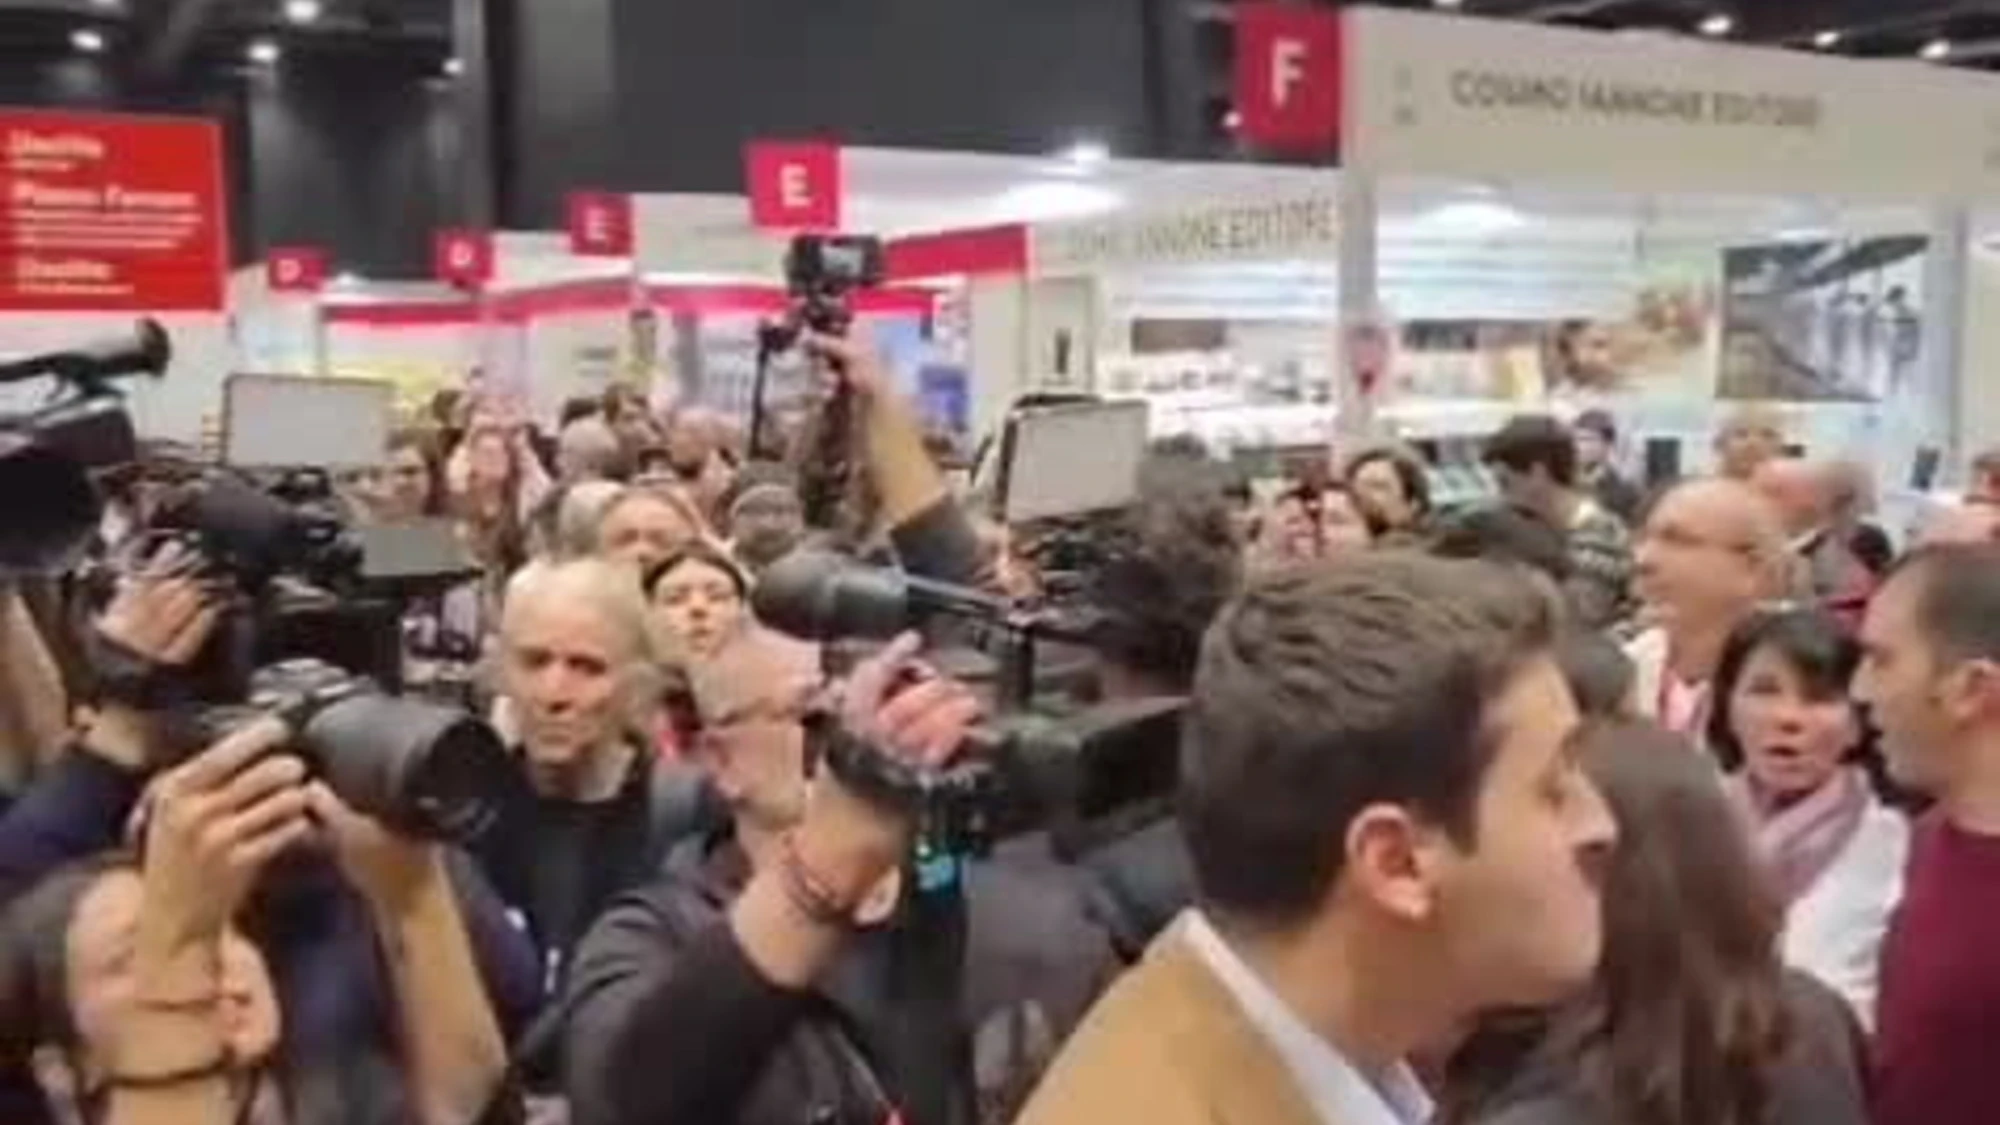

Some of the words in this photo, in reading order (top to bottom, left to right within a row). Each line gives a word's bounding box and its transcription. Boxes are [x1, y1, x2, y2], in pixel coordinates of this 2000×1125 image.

[1271, 38, 1307, 107] F
[779, 163, 811, 208] E
[584, 205, 612, 242] E
